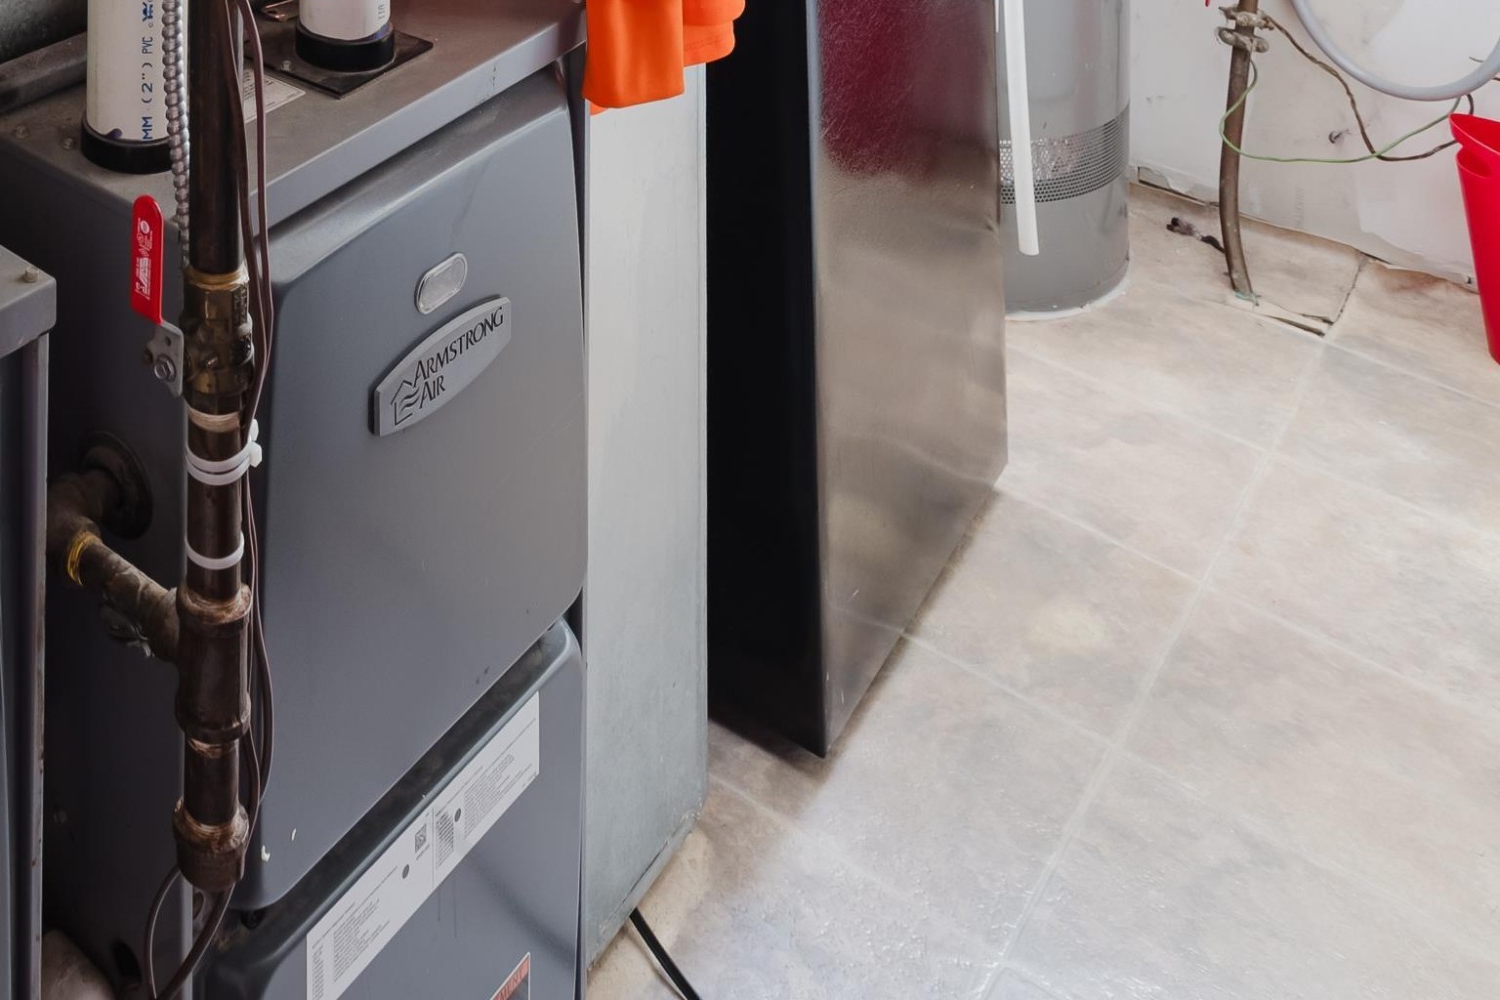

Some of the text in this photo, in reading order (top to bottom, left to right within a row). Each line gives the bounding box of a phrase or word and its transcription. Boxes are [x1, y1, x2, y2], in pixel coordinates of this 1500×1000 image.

[142, 37, 153, 54] PVC
[413, 306, 503, 388] ARMSTRONG
[419, 375, 446, 409] AIR
